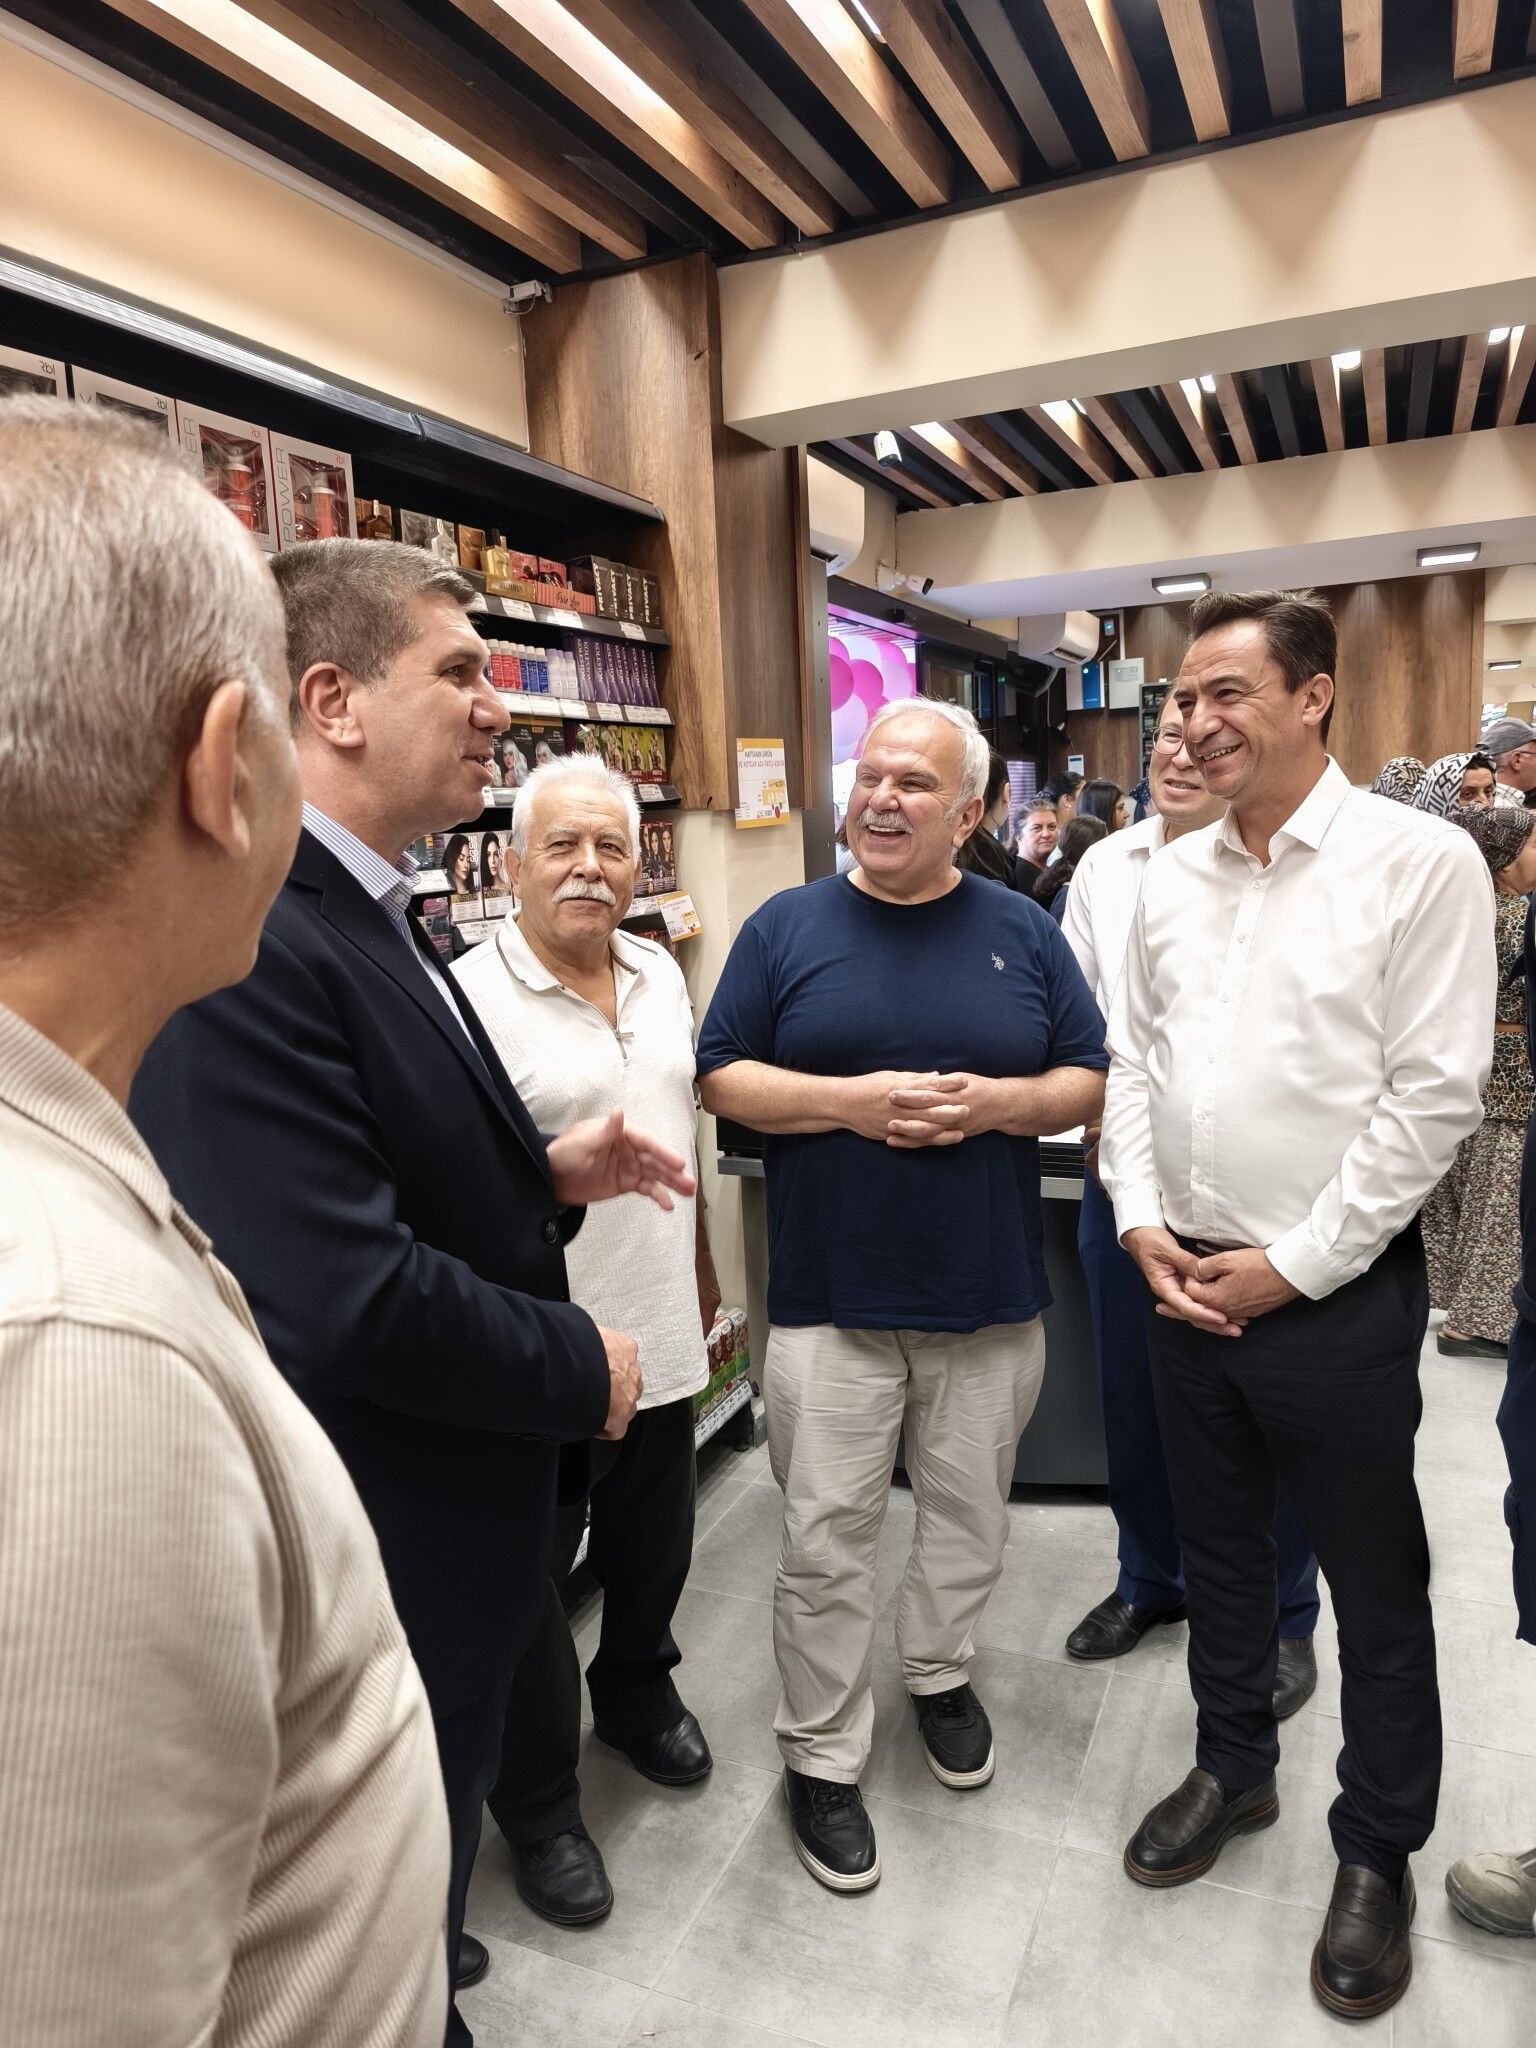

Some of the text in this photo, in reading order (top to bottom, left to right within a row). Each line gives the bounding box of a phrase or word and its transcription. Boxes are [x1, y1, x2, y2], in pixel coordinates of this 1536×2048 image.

[275, 447, 294, 542] POWER
[593, 562, 605, 611] PRIVACY
[626, 573, 634, 620] PRIVACY
[594, 642, 603, 682] KOLESTON
